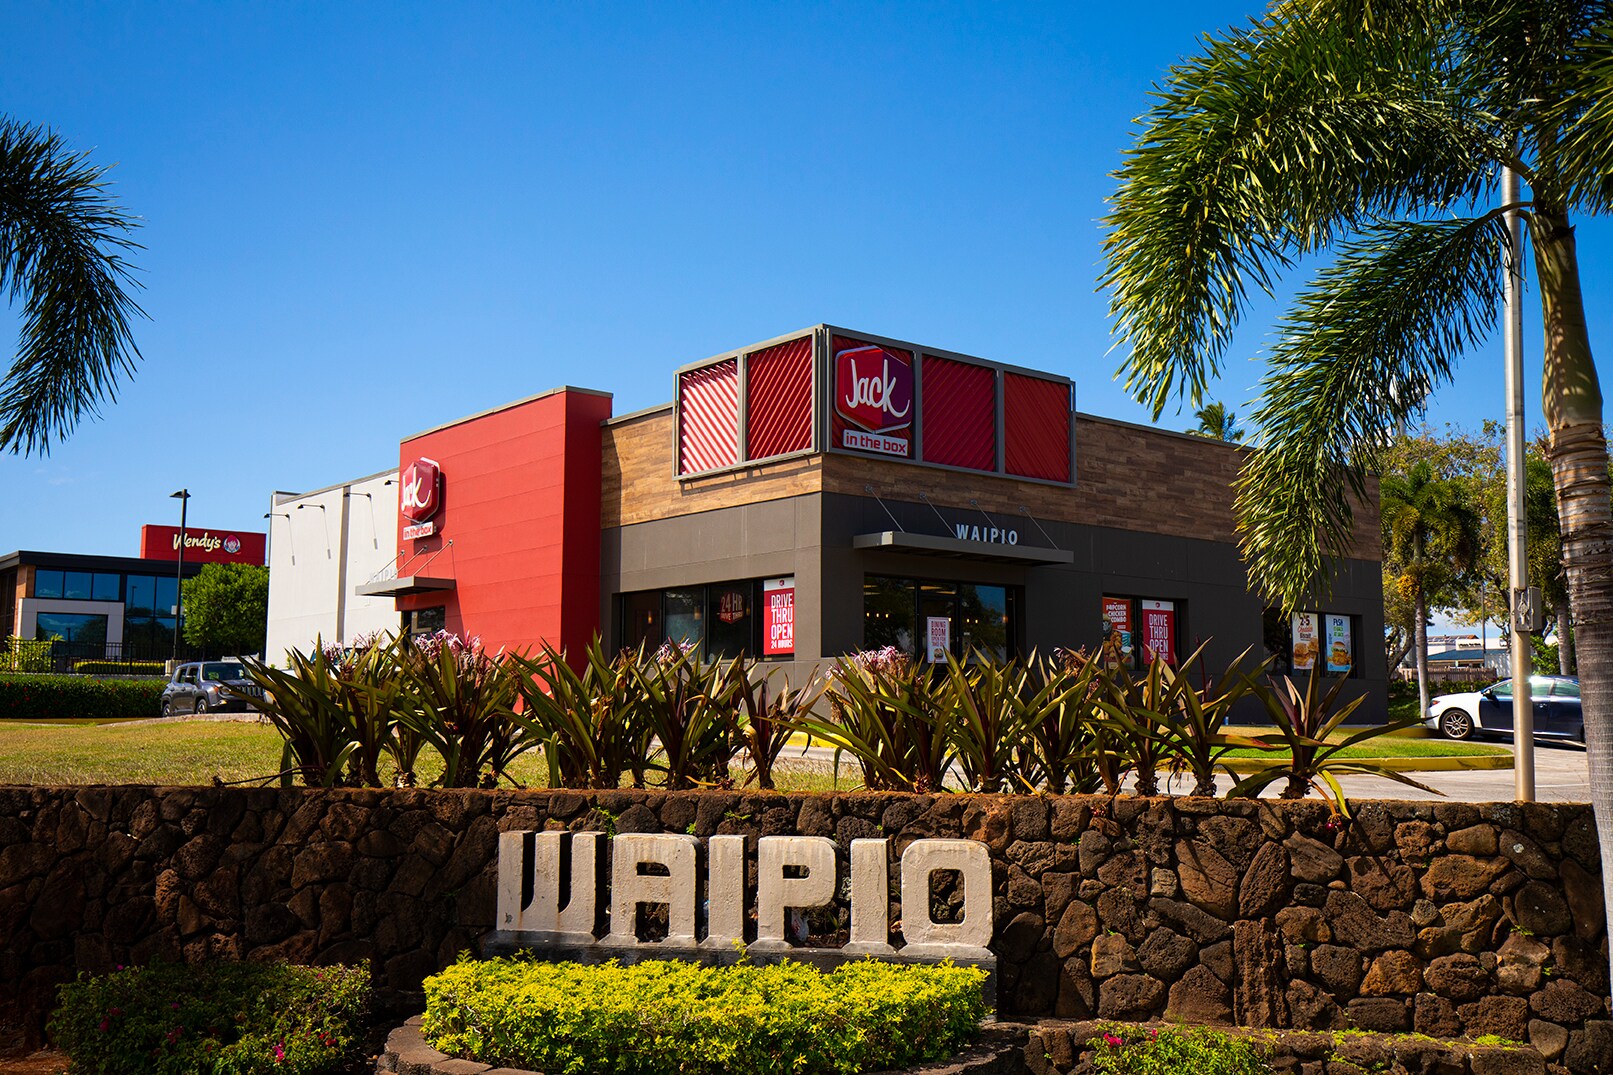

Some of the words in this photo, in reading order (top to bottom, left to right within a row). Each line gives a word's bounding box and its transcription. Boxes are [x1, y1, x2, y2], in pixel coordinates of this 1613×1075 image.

[845, 358, 911, 418] Jack
[845, 432, 858, 446] in
[860, 435, 881, 449] the
[883, 439, 907, 453] box
[410, 527, 419, 536] the
[420, 525, 432, 534] box
[956, 523, 1018, 546] WAIPIO
[172, 532, 222, 553] Wendy's
[720, 593, 731, 613] 24
[732, 592, 743, 612] HR
[770, 593, 793, 609] DRIVE
[771, 607, 793, 624] THRU
[1148, 613, 1168, 627] DRIVE
[770, 623, 793, 640] OPEN
[931, 620, 946, 629] DINING
[931, 627, 946, 637] ROOM
[1149, 626, 1169, 639] THRU
[770, 640, 777, 649] 24
[777, 639, 793, 649] HOURS
[1150, 639, 1169, 653] OPEN
[496, 830, 995, 952] WAIPIO
